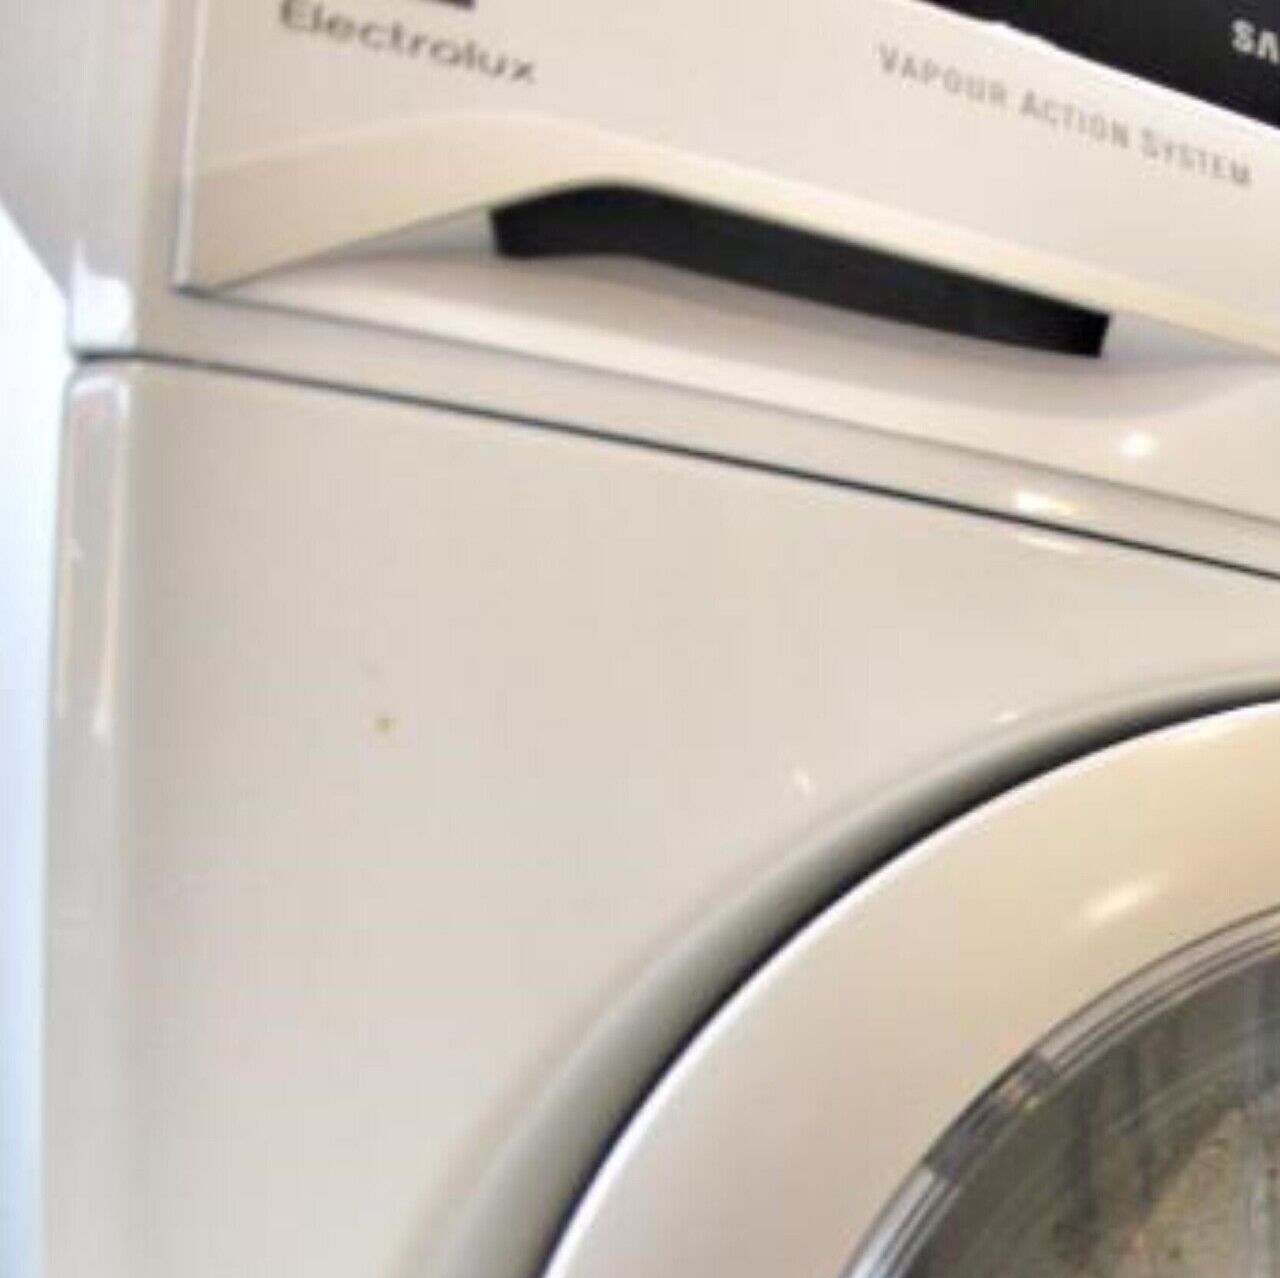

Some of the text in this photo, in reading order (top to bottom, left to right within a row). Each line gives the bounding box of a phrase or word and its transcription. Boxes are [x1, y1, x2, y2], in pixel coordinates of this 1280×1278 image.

[278, 1, 536, 85] Electrolux
[873, 44, 1252, 187] VAPOUR ACTION SYSTEM
